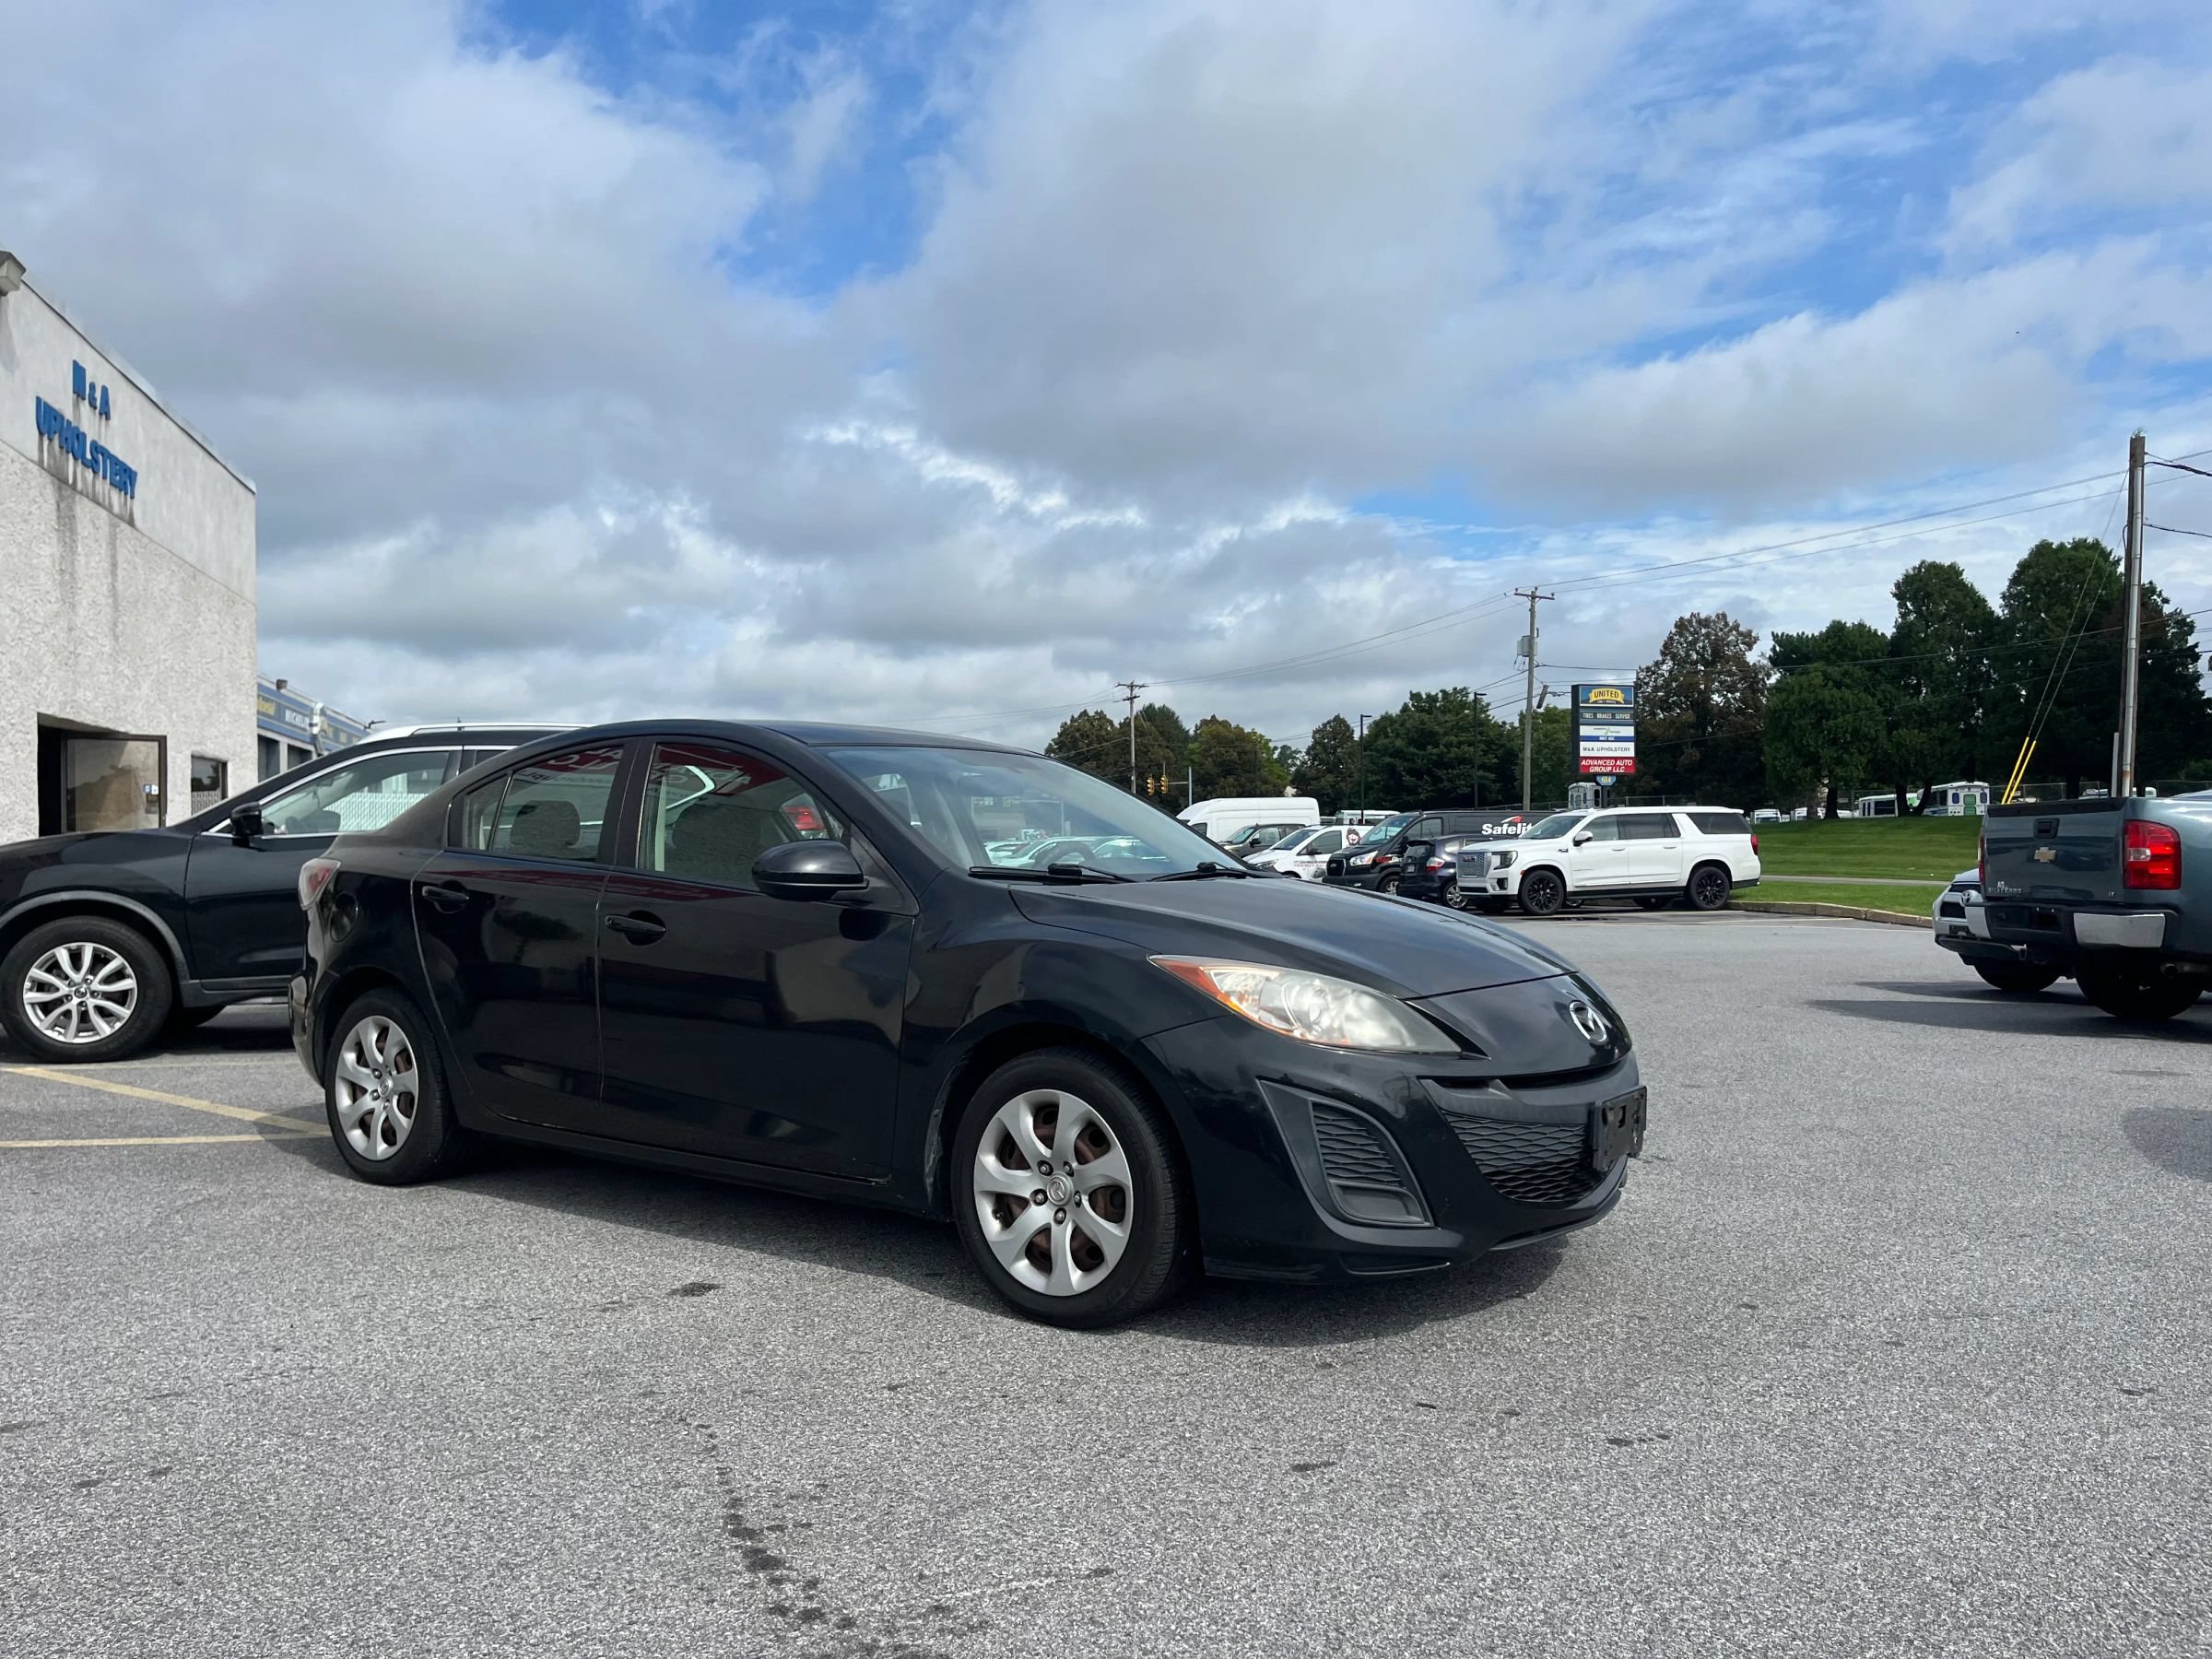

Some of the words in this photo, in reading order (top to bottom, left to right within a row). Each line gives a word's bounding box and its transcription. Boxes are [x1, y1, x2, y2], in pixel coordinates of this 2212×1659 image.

[73, 359, 87, 401] M
[88, 382, 98, 410] &
[99, 384, 111, 421] A
[35, 395, 138, 500] UPHOLSTERY
[1594, 689, 1619, 699] UNITED
